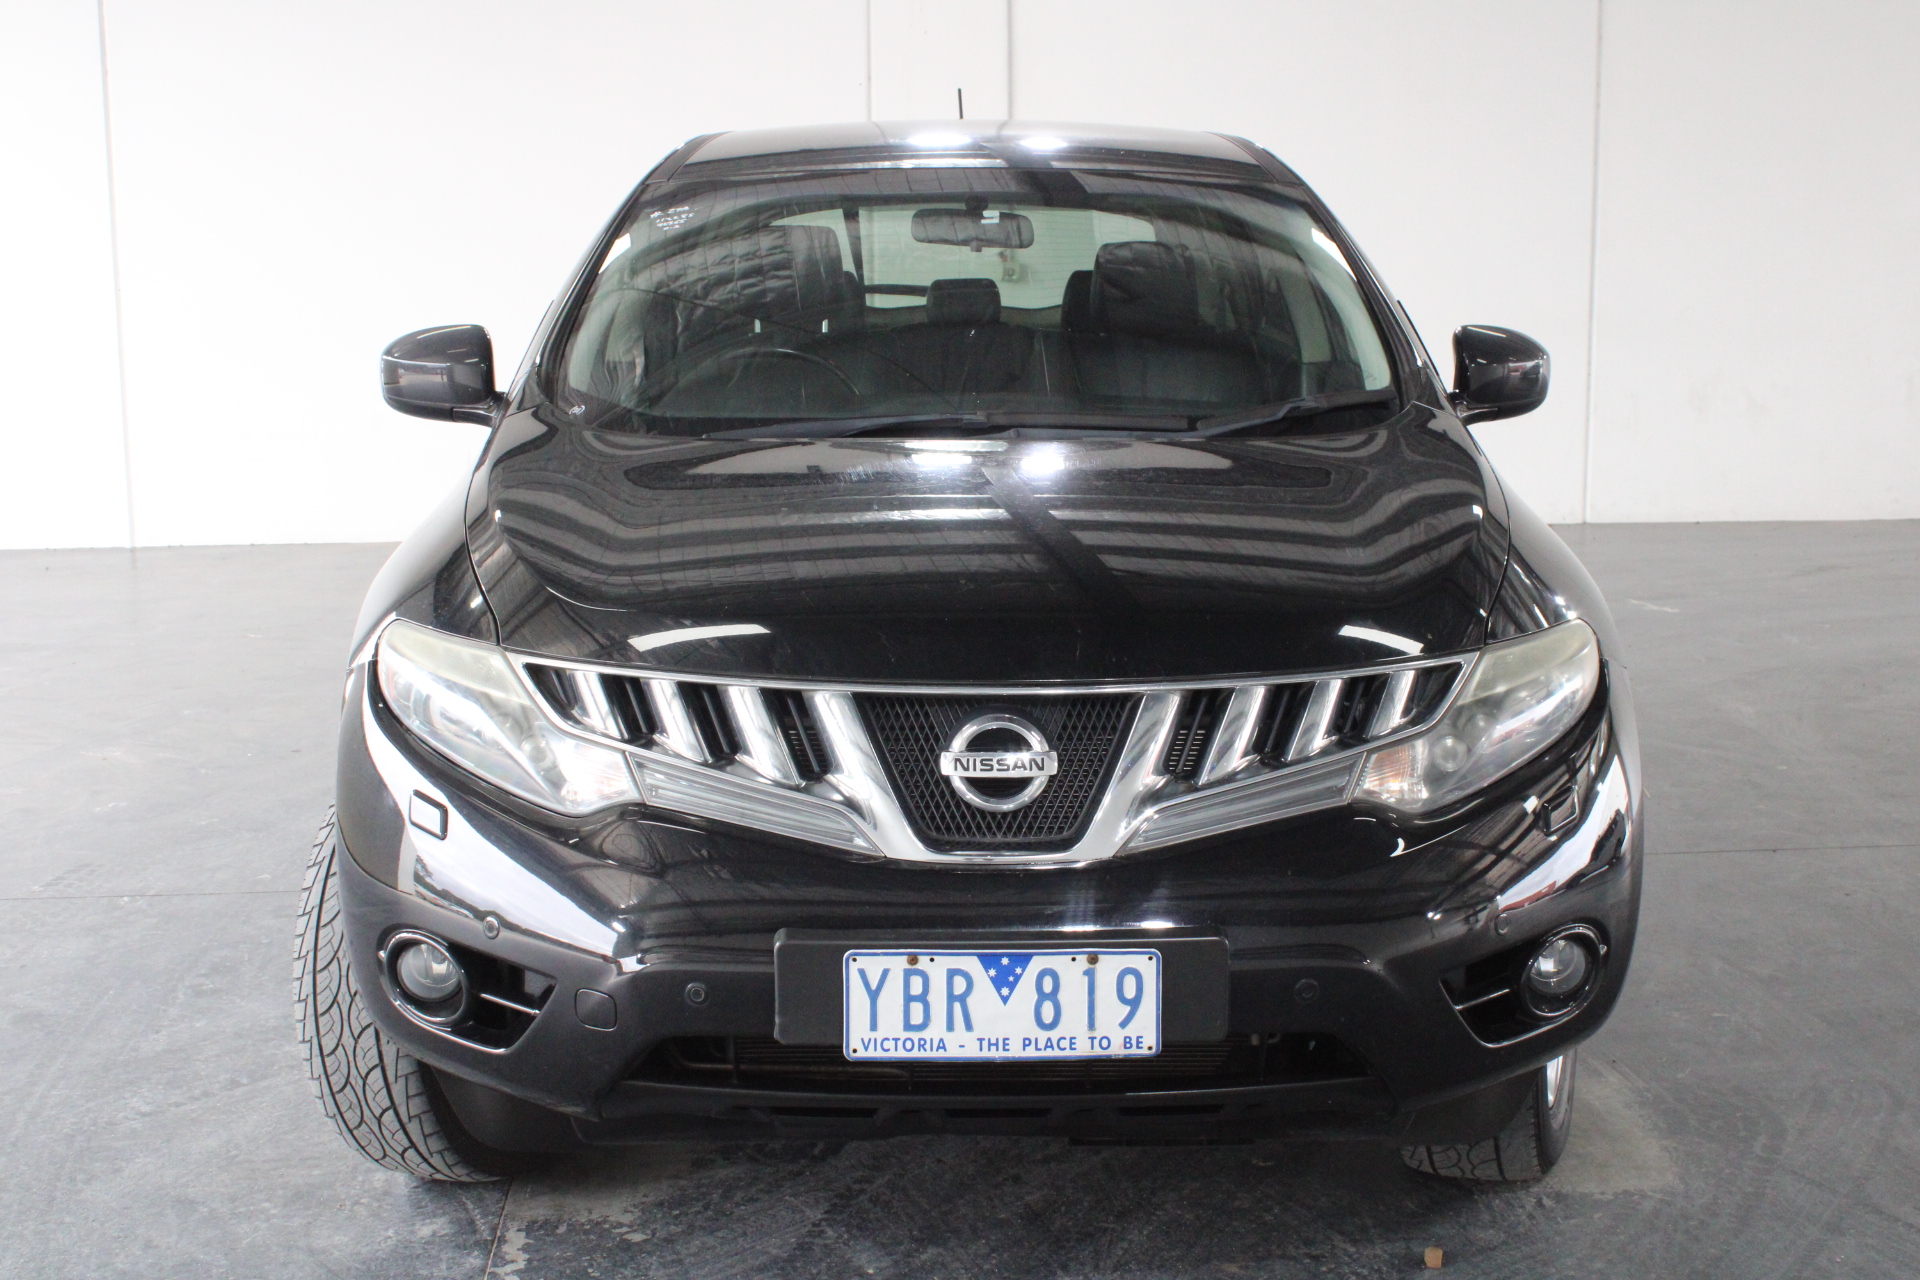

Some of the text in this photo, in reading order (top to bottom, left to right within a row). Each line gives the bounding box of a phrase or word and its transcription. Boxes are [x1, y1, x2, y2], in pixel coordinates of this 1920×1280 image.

[953, 757, 1045, 772] NISSAN
[856, 966, 1145, 1033] YBR 819
[860, 1037, 947, 1053] VICTORIA
[976, 1037, 1010, 1052] THE
[1022, 1036, 1077, 1051] PLACE
[1088, 1036, 1112, 1051] TO
[1123, 1035, 1144, 1050] BE
